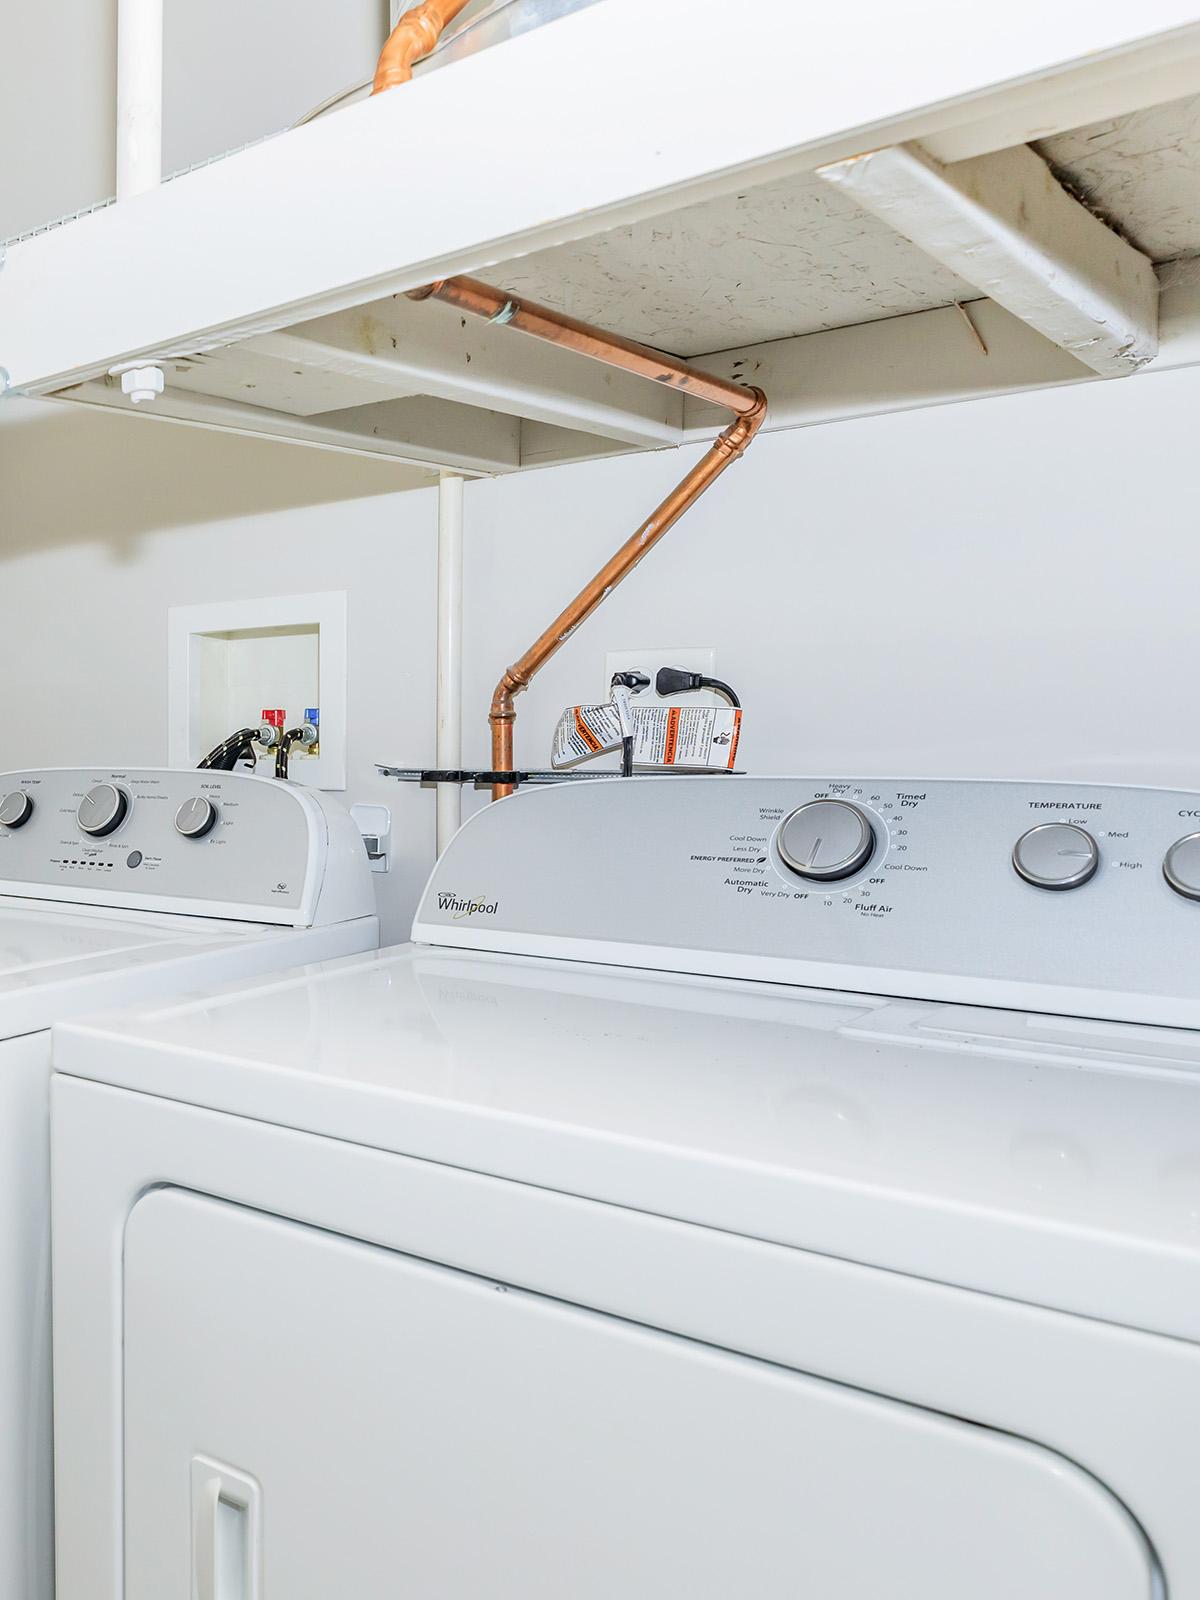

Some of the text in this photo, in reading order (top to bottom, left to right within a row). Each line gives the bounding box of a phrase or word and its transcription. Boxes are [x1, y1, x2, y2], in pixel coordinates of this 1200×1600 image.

[666, 716, 676, 763] ADVERTENCIA
[901, 800, 919, 809] Dry
[1028, 801, 1103, 810] TEMPERATURE
[1107, 830, 1129, 839] Med
[904, 864, 928, 872] Down
[1119, 861, 1143, 870] High
[724, 878, 768, 888] Automatic
[737, 886, 753, 894] Dry
[777, 891, 790, 899] Dry
[438, 897, 498, 916] Whirlpool
[854, 903, 893, 913] Fluff Air
